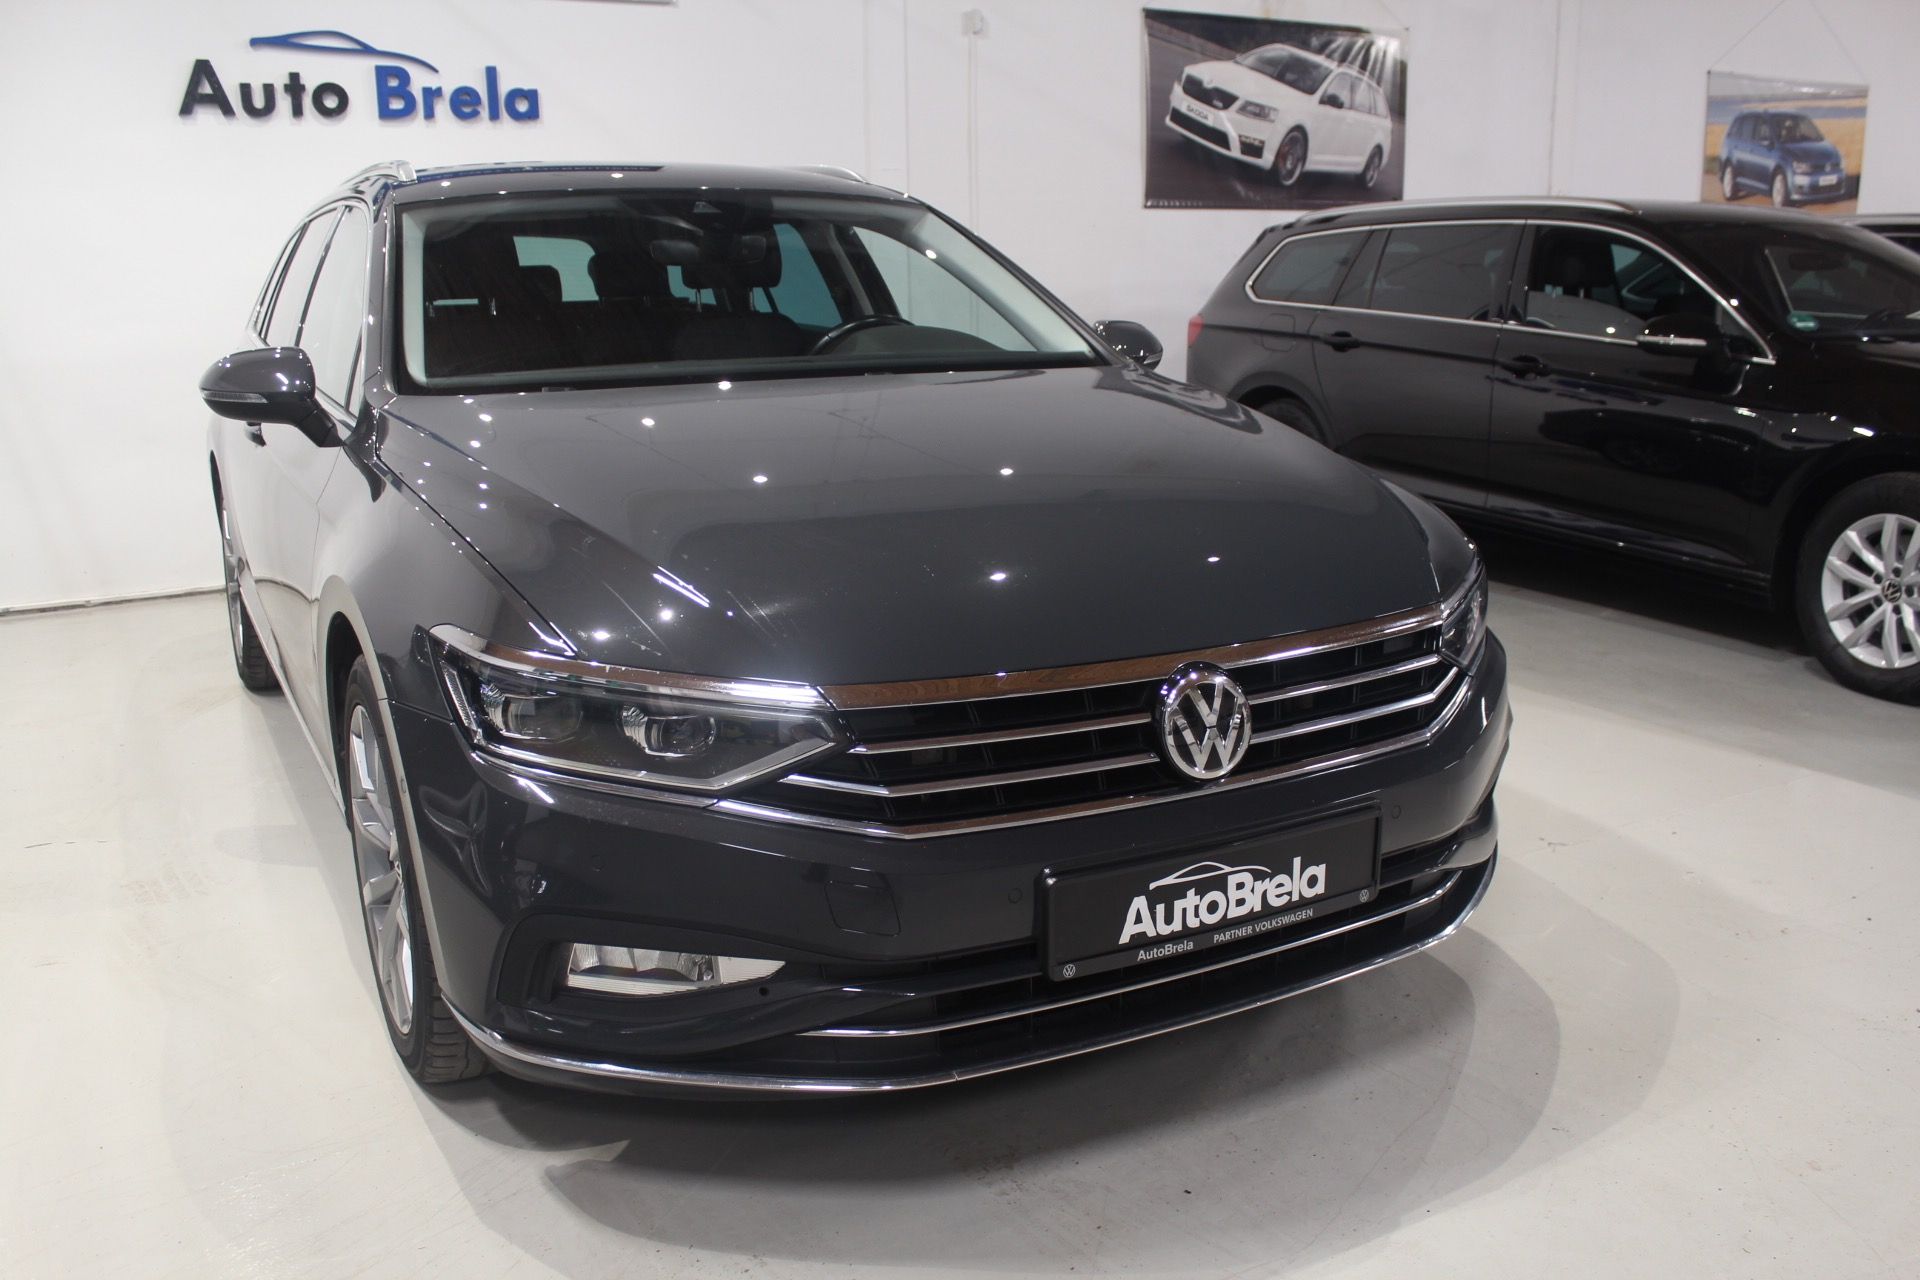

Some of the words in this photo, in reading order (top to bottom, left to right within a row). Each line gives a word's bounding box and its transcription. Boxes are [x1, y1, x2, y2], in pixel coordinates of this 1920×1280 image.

[178, 59, 350, 118] Auto
[374, 65, 540, 121] Brela
[1118, 856, 1327, 945] AutoBrela
[1137, 939, 1194, 962] AutoBrela
[1213, 925, 1253, 944] PARTNER
[1254, 908, 1313, 933] VOLKSWAGEN
